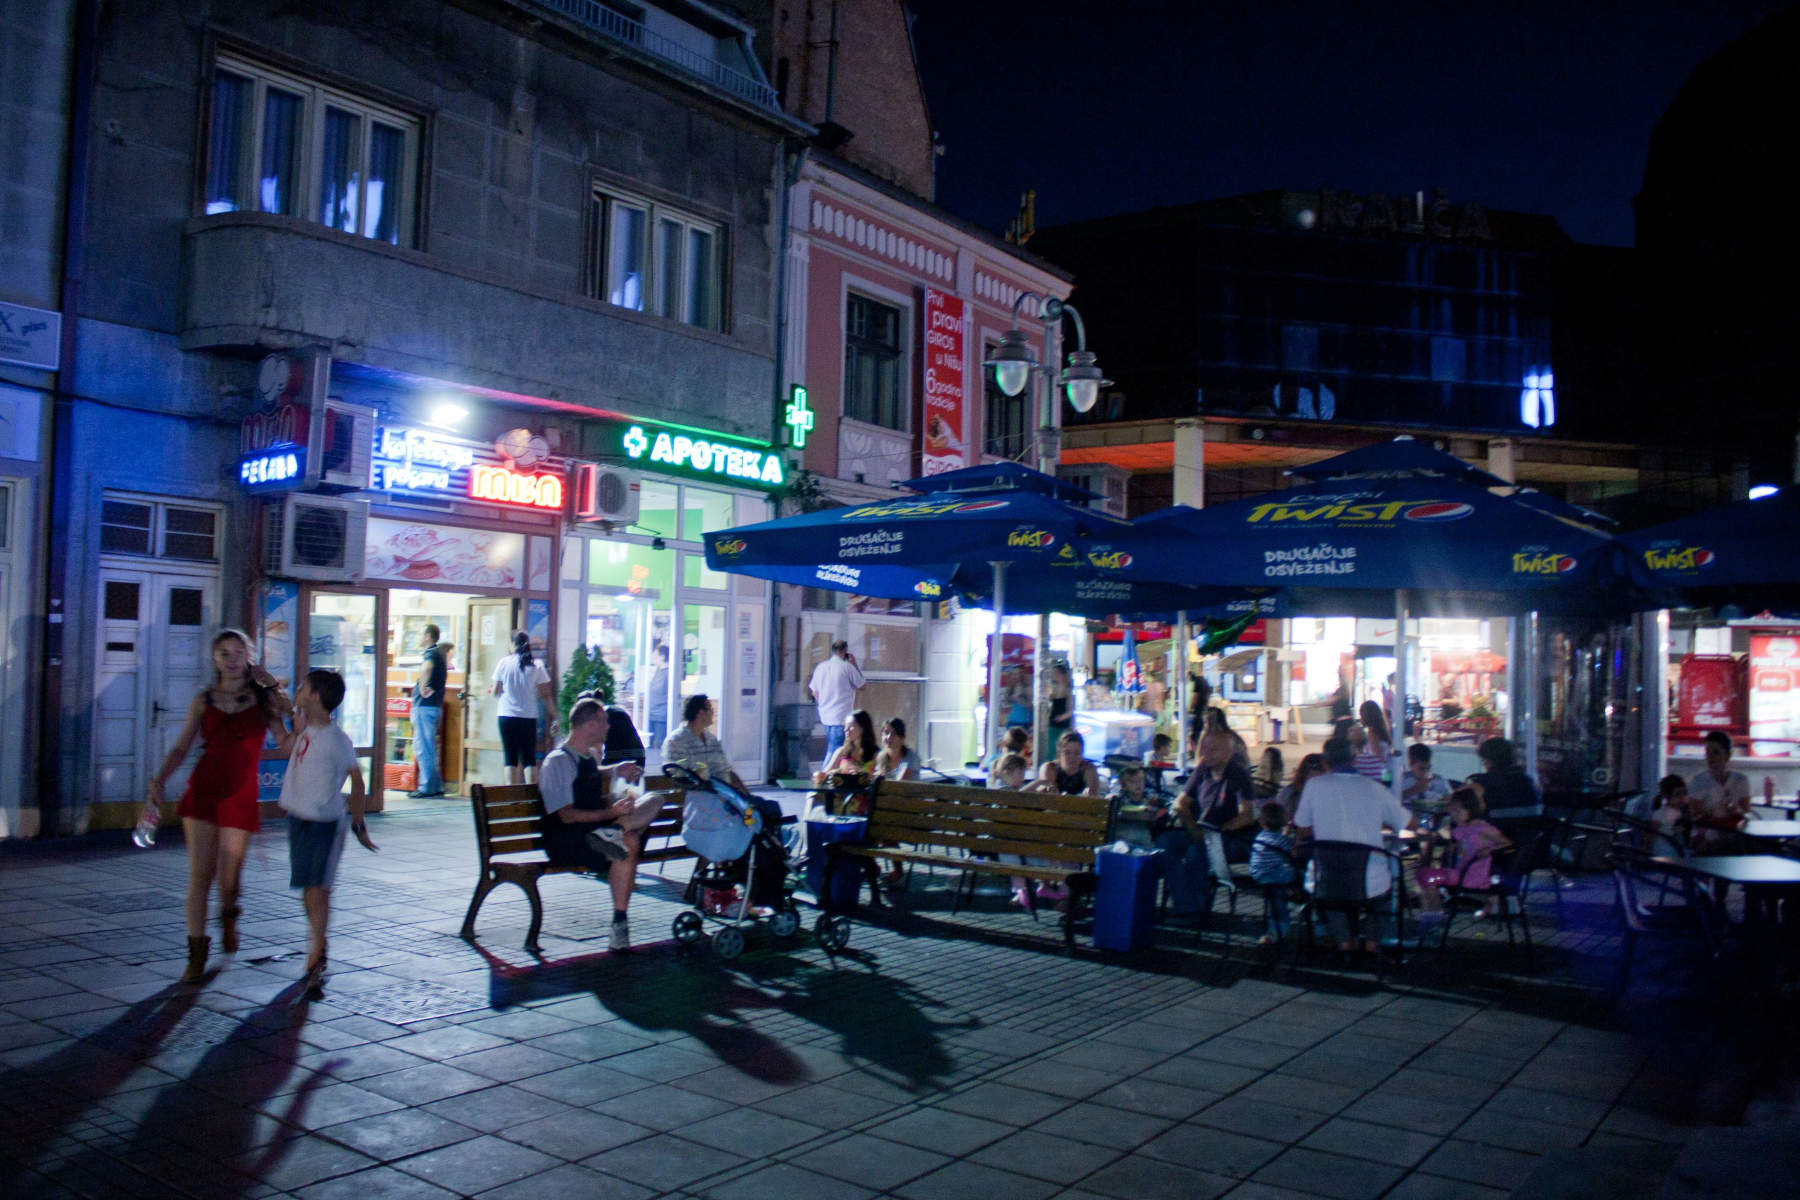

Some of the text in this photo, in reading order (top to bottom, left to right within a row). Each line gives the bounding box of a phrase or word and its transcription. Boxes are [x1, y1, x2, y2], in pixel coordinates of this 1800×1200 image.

[927, 290, 944, 308] Prvi
[933, 310, 962, 334] pravi
[927, 328, 955, 351] GIROS
[935, 353, 943, 365] u
[926, 367, 936, 393] 6
[650, 432, 783, 483] APOTEKA
[839, 530, 904, 548] DRUGAČIJE
[838, 542, 903, 559] OSVEŽENJE
[1264, 544, 1358, 563] DRUGAČIJE
[1264, 560, 1357, 578] OSVEŽENJE
